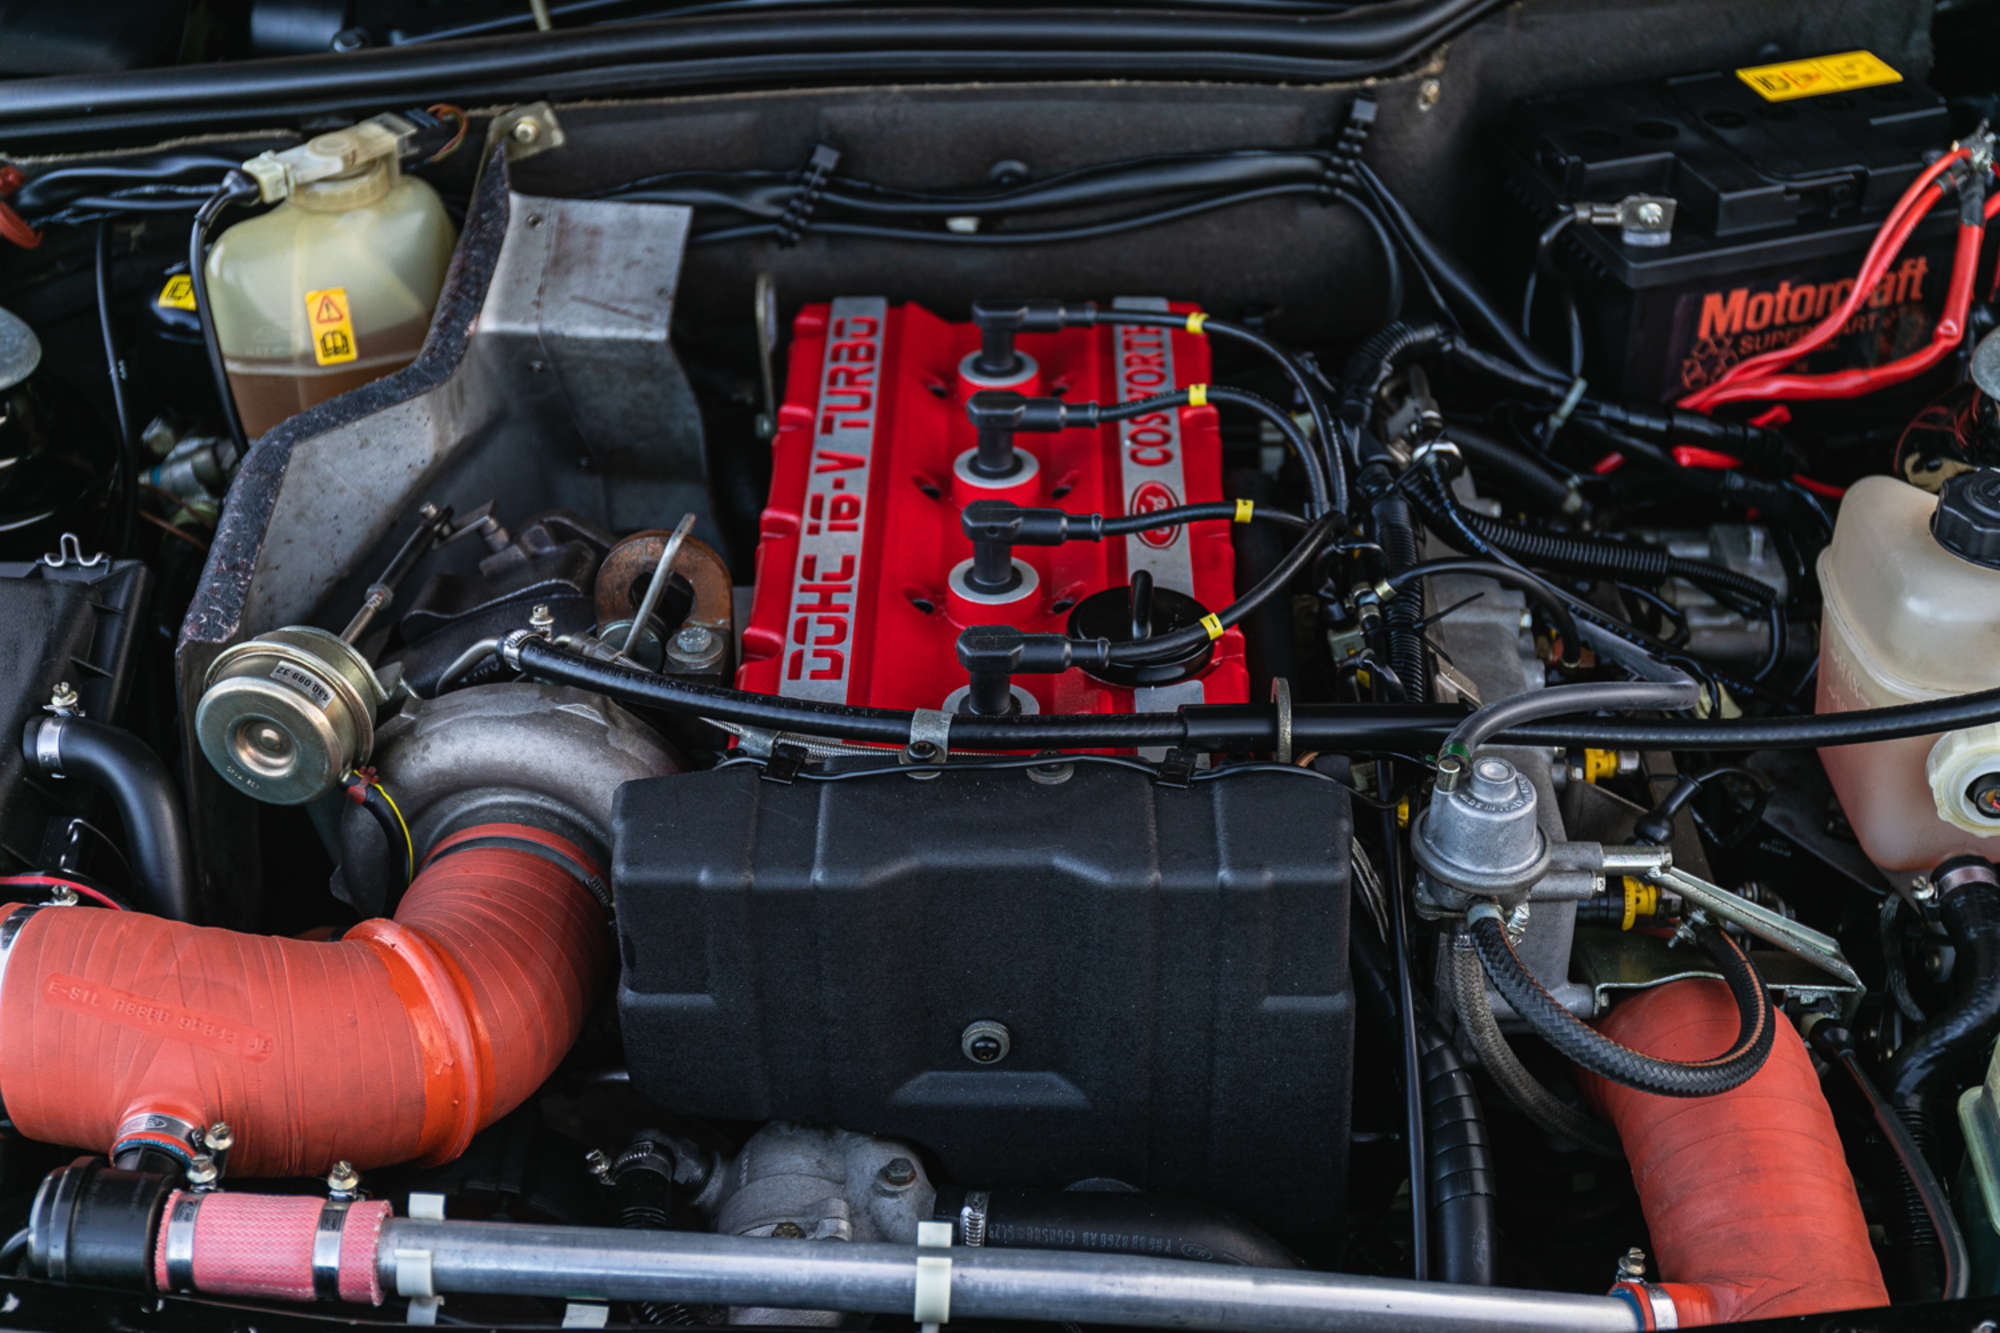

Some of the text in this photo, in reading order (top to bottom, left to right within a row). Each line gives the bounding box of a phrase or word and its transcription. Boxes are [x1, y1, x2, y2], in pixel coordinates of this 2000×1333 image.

[1698, 256, 1928, 339] Motorcaft
[820, 315, 879, 436] TURBO
[787, 554, 855, 681] DOHC
